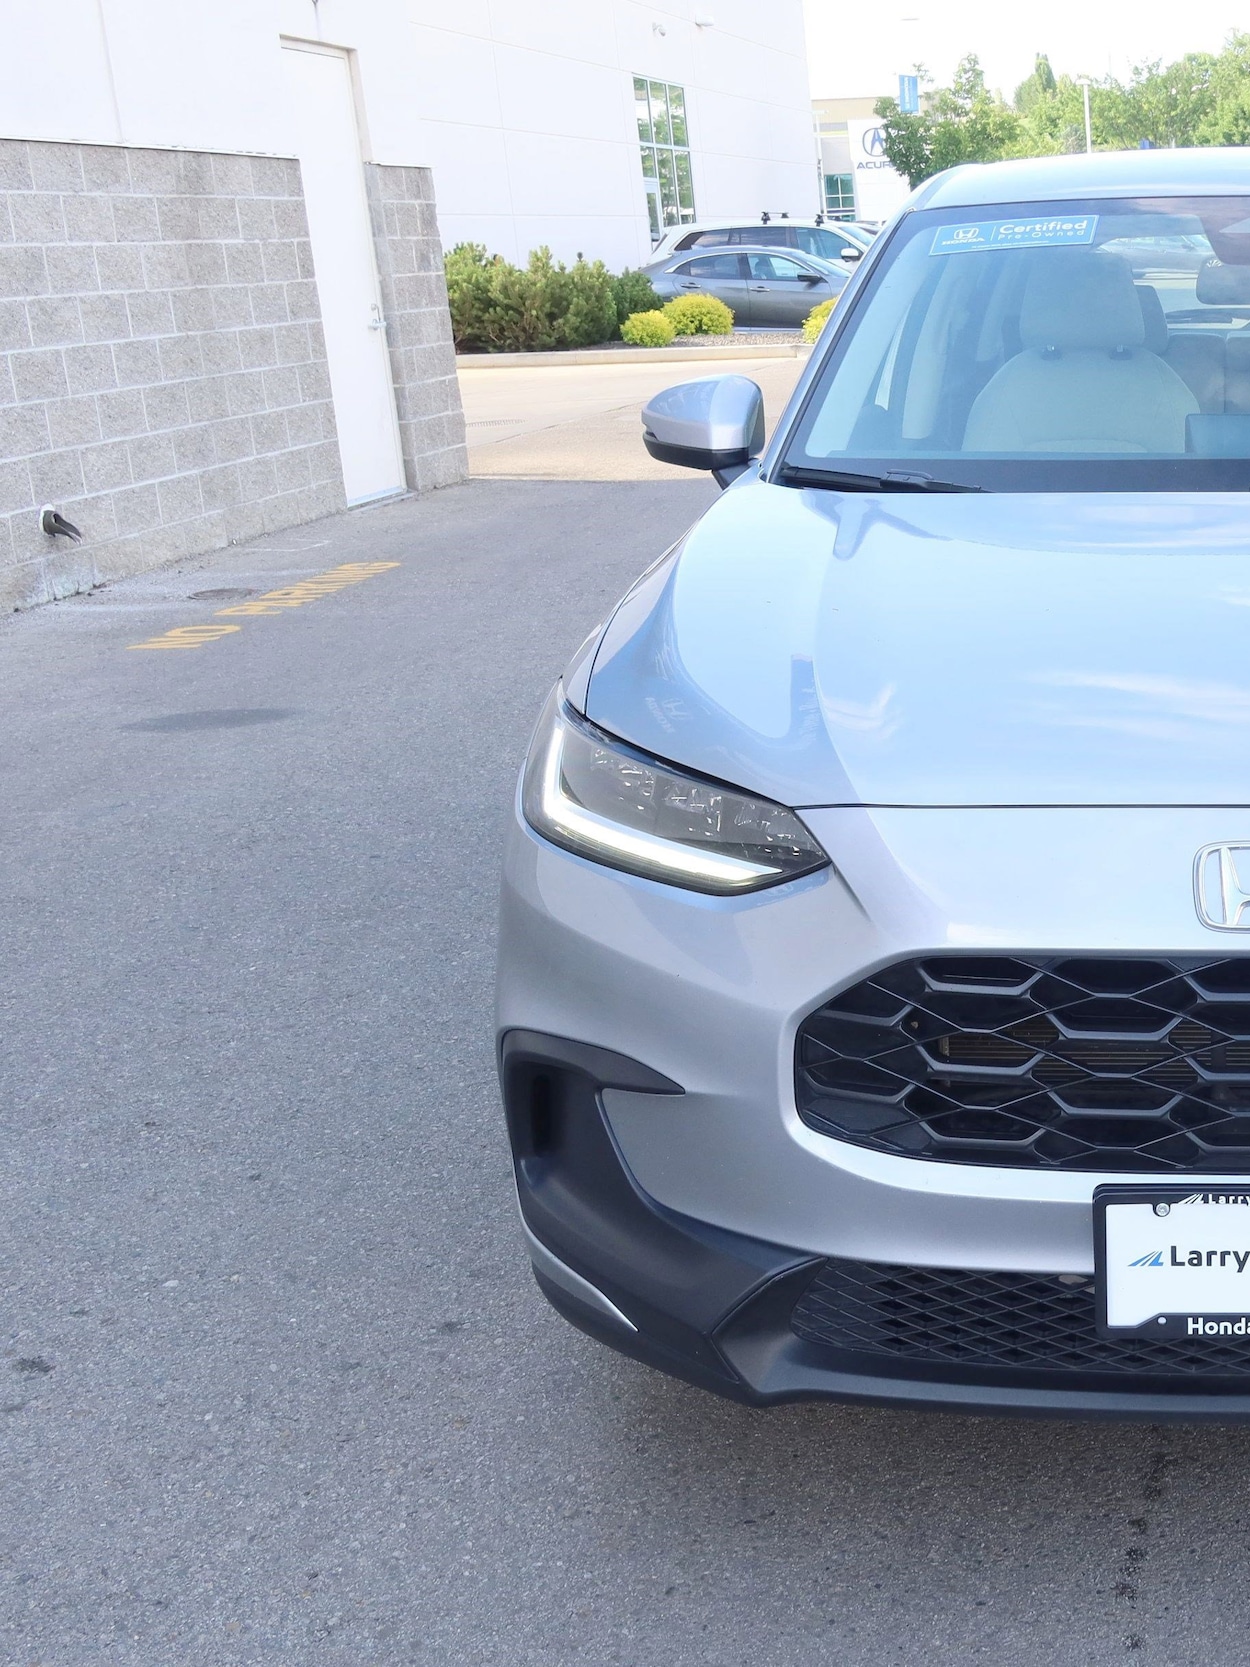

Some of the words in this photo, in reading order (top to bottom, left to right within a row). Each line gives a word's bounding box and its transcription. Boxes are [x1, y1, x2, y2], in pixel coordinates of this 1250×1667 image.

[856, 160, 897, 170] ACUR
[999, 219, 1088, 234] Certified
[997, 229, 1085, 241] Pre-Owned
[125, 624, 242, 650] NO
[213, 561, 401, 616] PARKING
